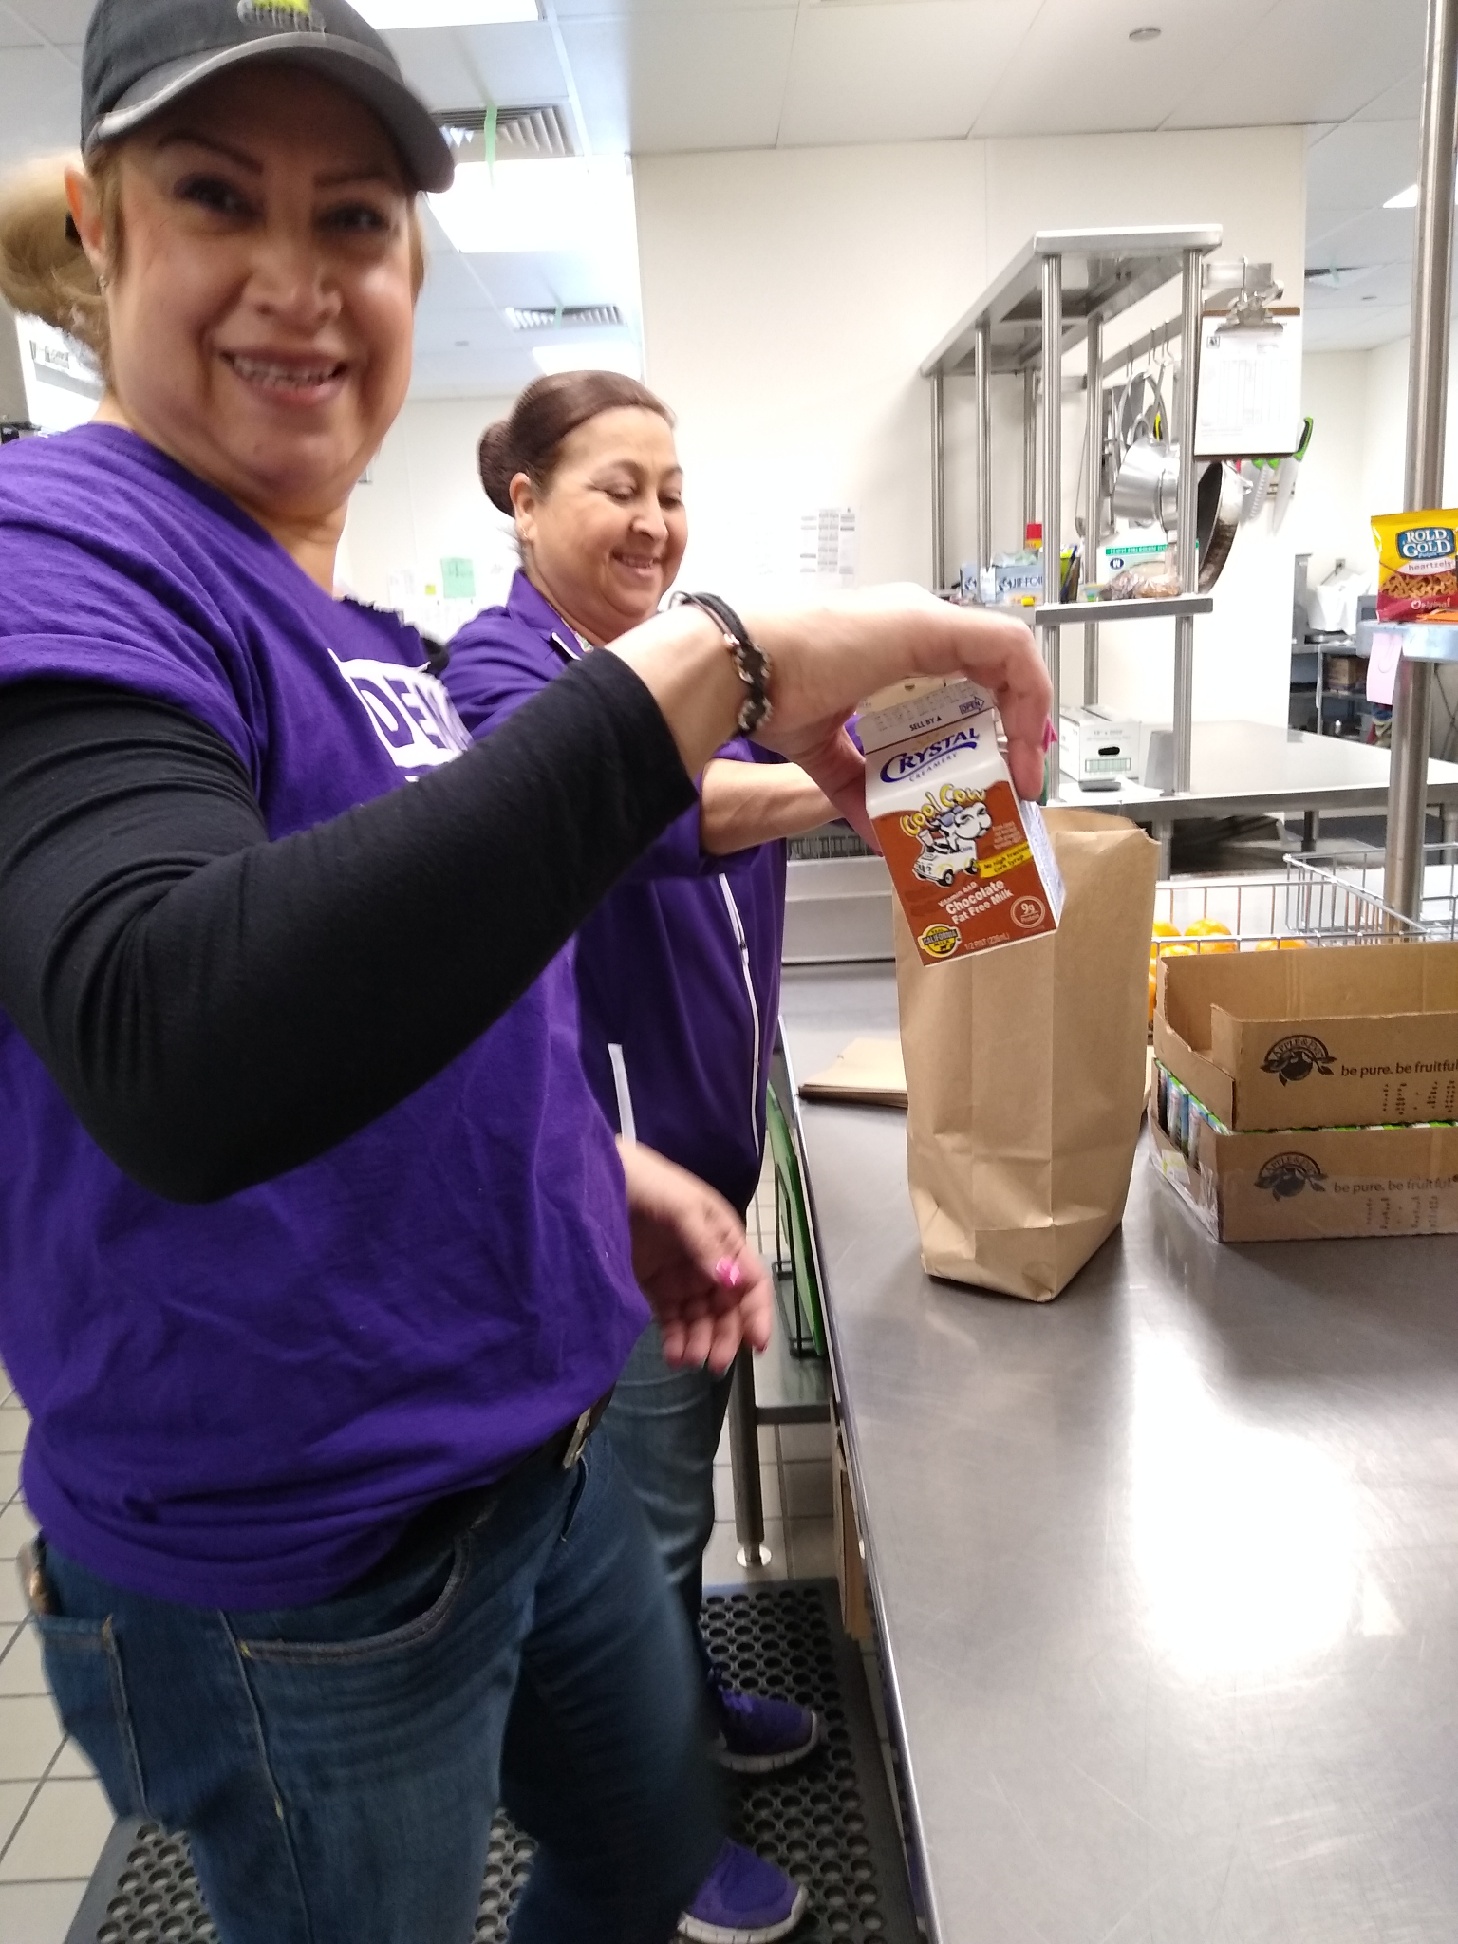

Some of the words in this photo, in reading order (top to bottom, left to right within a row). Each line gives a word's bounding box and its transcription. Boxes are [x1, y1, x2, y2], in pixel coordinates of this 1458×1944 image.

[1406, 529, 1448, 544] ROLD
[1402, 540, 1451, 557] GOLD
[961, 700, 980, 713] OPEN
[909, 720, 924, 731] SELL
[925, 718, 935, 726] BY
[880, 728, 980, 783] CRYSTAL
[945, 880, 1005, 915] Chocolate
[951, 911, 970, 925] Fat
[968, 901, 991, 916] Free
[990, 889, 1014, 906] Milk
[1020, 902, 1036, 915] 9g
[1341, 1065, 1357, 1076] be
[1395, 1062, 1412, 1074] be
[1334, 1182, 1350, 1193] be
[1388, 1180, 1404, 1191] be
